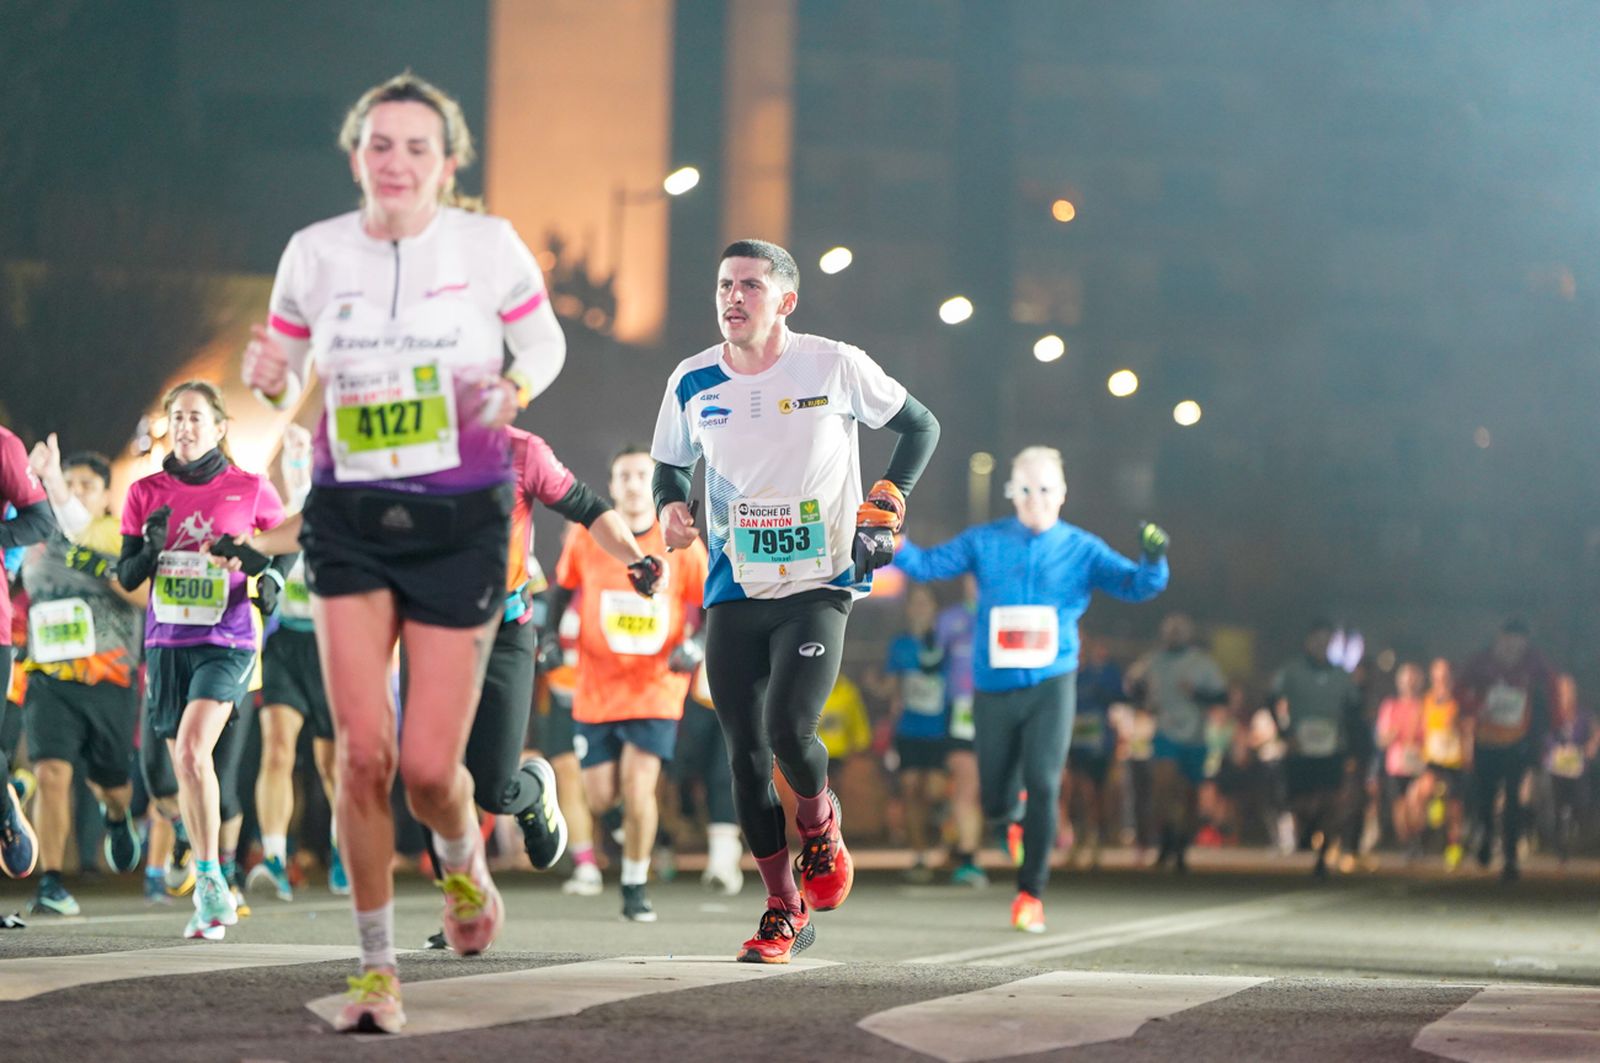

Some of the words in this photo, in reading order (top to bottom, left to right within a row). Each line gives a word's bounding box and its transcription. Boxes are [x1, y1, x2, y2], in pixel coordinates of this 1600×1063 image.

[357, 400, 424, 439] 4127
[740, 518, 758, 528] SAN
[760, 515, 792, 527] ANTÓN
[750, 508, 779, 517] NOCHE
[780, 506, 792, 516] DE
[748, 526, 811, 555] 7953
[163, 577, 214, 600] 4500
